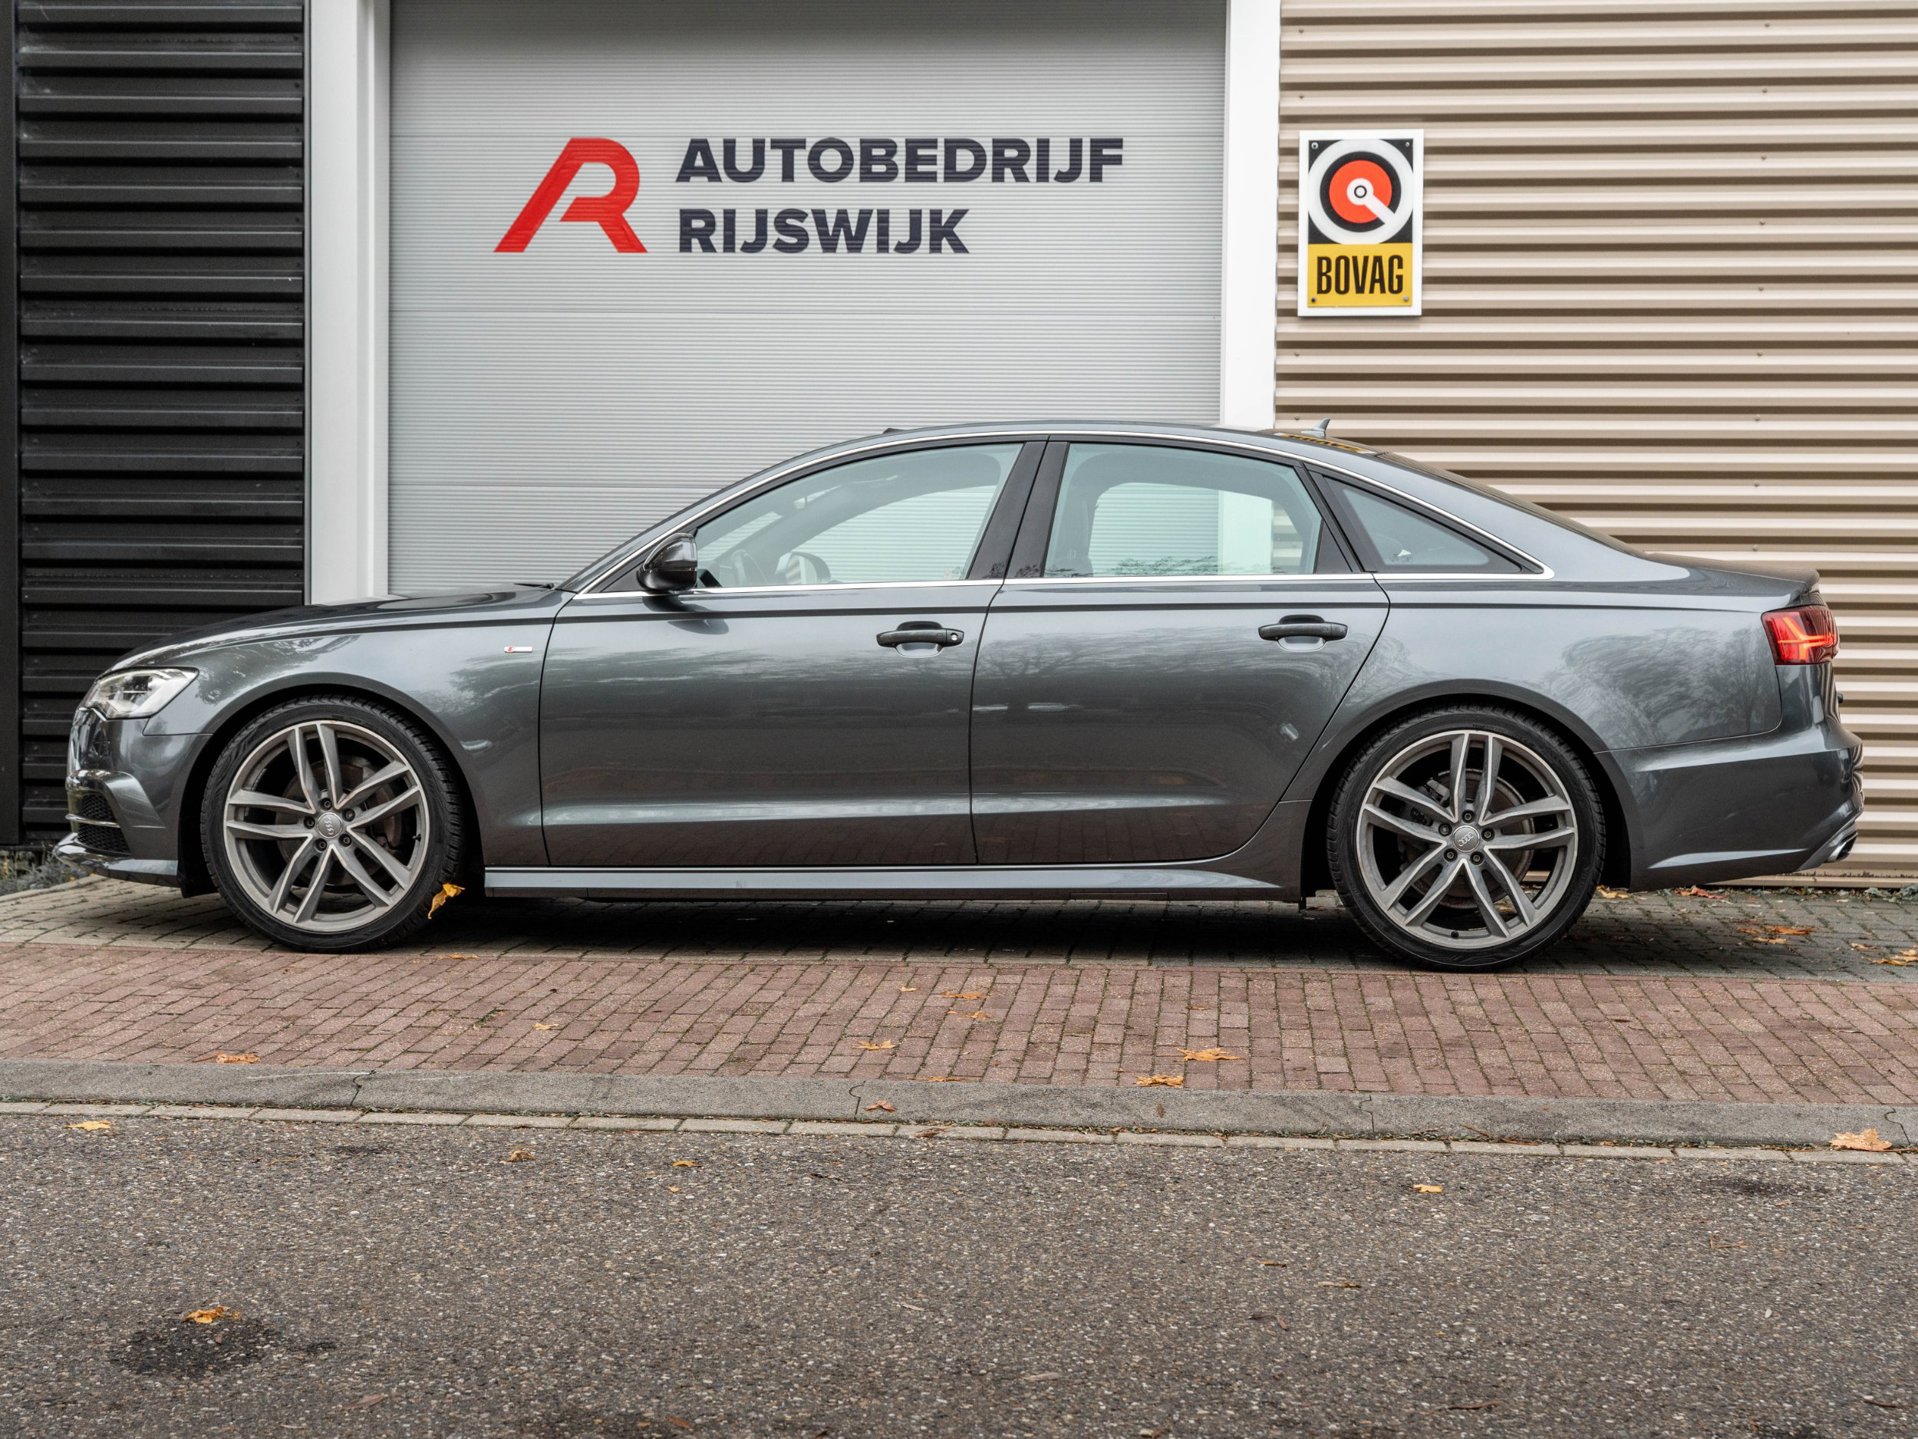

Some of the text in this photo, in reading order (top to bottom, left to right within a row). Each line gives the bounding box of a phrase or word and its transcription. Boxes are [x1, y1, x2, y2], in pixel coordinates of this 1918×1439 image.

[675, 137, 1123, 183] AUTOBEDRIJF
[679, 208, 970, 254] RIJSWIJK
[1316, 254, 1404, 295] BOVAG
